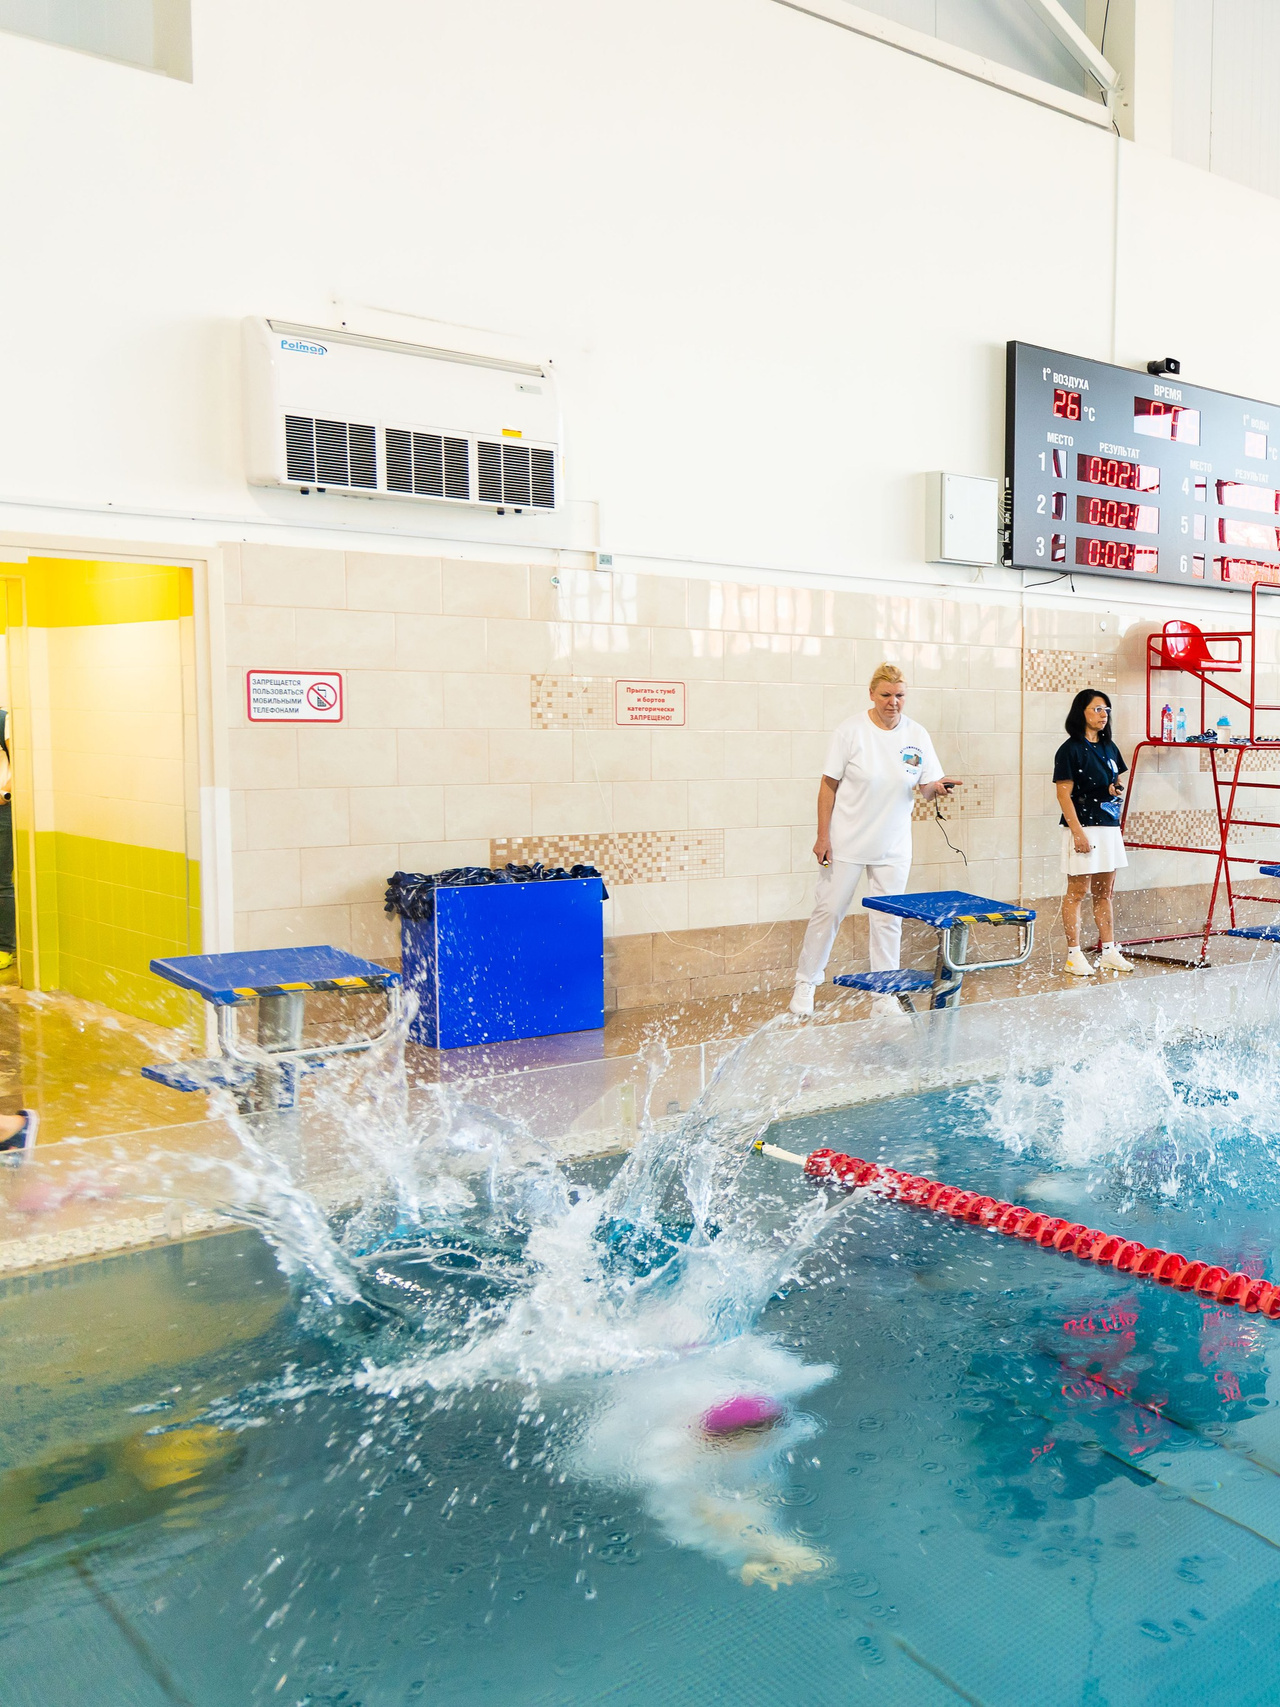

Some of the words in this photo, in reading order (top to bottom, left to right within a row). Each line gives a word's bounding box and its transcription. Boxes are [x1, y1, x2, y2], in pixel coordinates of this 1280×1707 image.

[281, 340, 325, 356] Polman
[1053, 372, 1090, 391] ВОЗДУХА
[1153, 384, 1182, 402] ВРЕМЯ
[1053, 389, 1079, 420] 26
[1251, 418, 1270, 431] ВОДЫ
[1047, 431, 1074, 447] МЕСТО
[1099, 441, 1140, 459] РЕЗУЛЬТАТ
[1038, 452, 1046, 471] 1
[1190, 459, 1213, 473] МЕСТО
[1235, 468, 1269, 484] РЕЗУЛЬТАТ
[1181, 477, 1190, 495] 4
[1036, 494, 1046, 515] 2
[1180, 515, 1189, 534] 5
[1035, 536, 1045, 557] 3
[1179, 554, 1188, 574] 6
